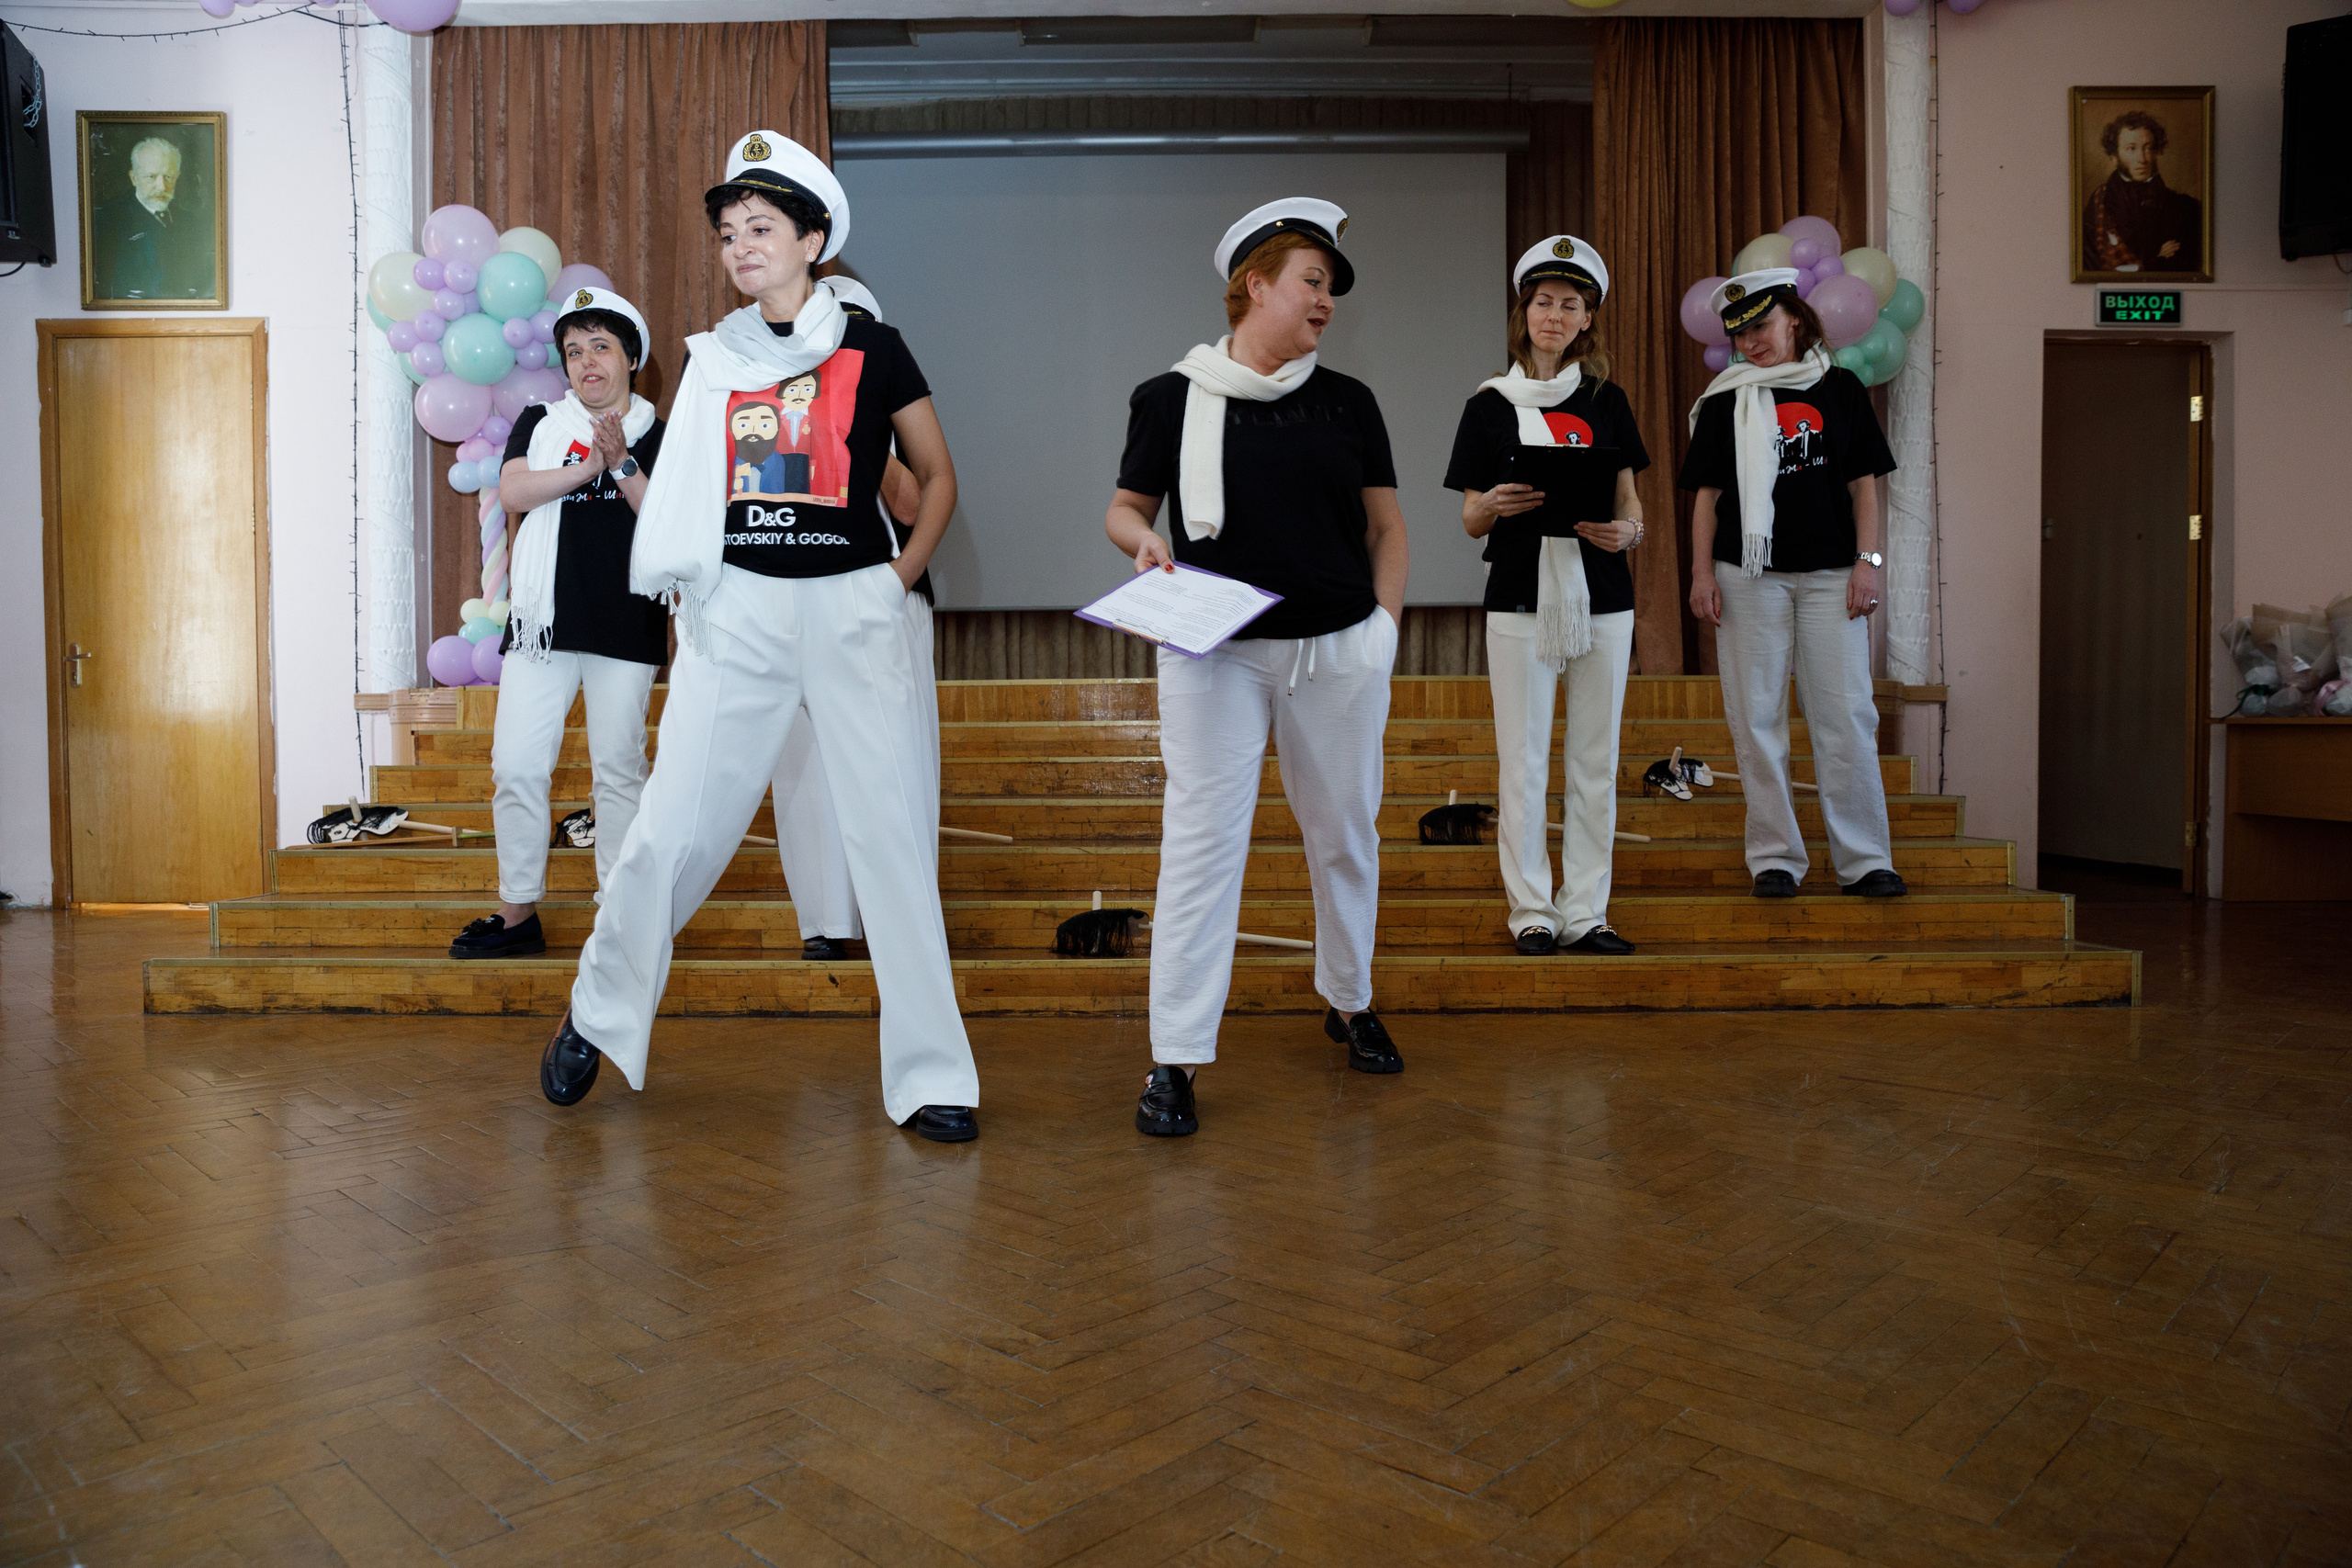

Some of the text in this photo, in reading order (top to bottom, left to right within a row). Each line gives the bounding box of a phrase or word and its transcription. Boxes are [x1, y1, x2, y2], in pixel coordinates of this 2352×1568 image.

[2106, 296, 2174, 310] ВЫХОД
[2115, 310, 2165, 320] EXIT
[747, 505, 797, 527] D&G
[786, 533, 796, 545] &
[798, 533, 851, 545] GOGOL
